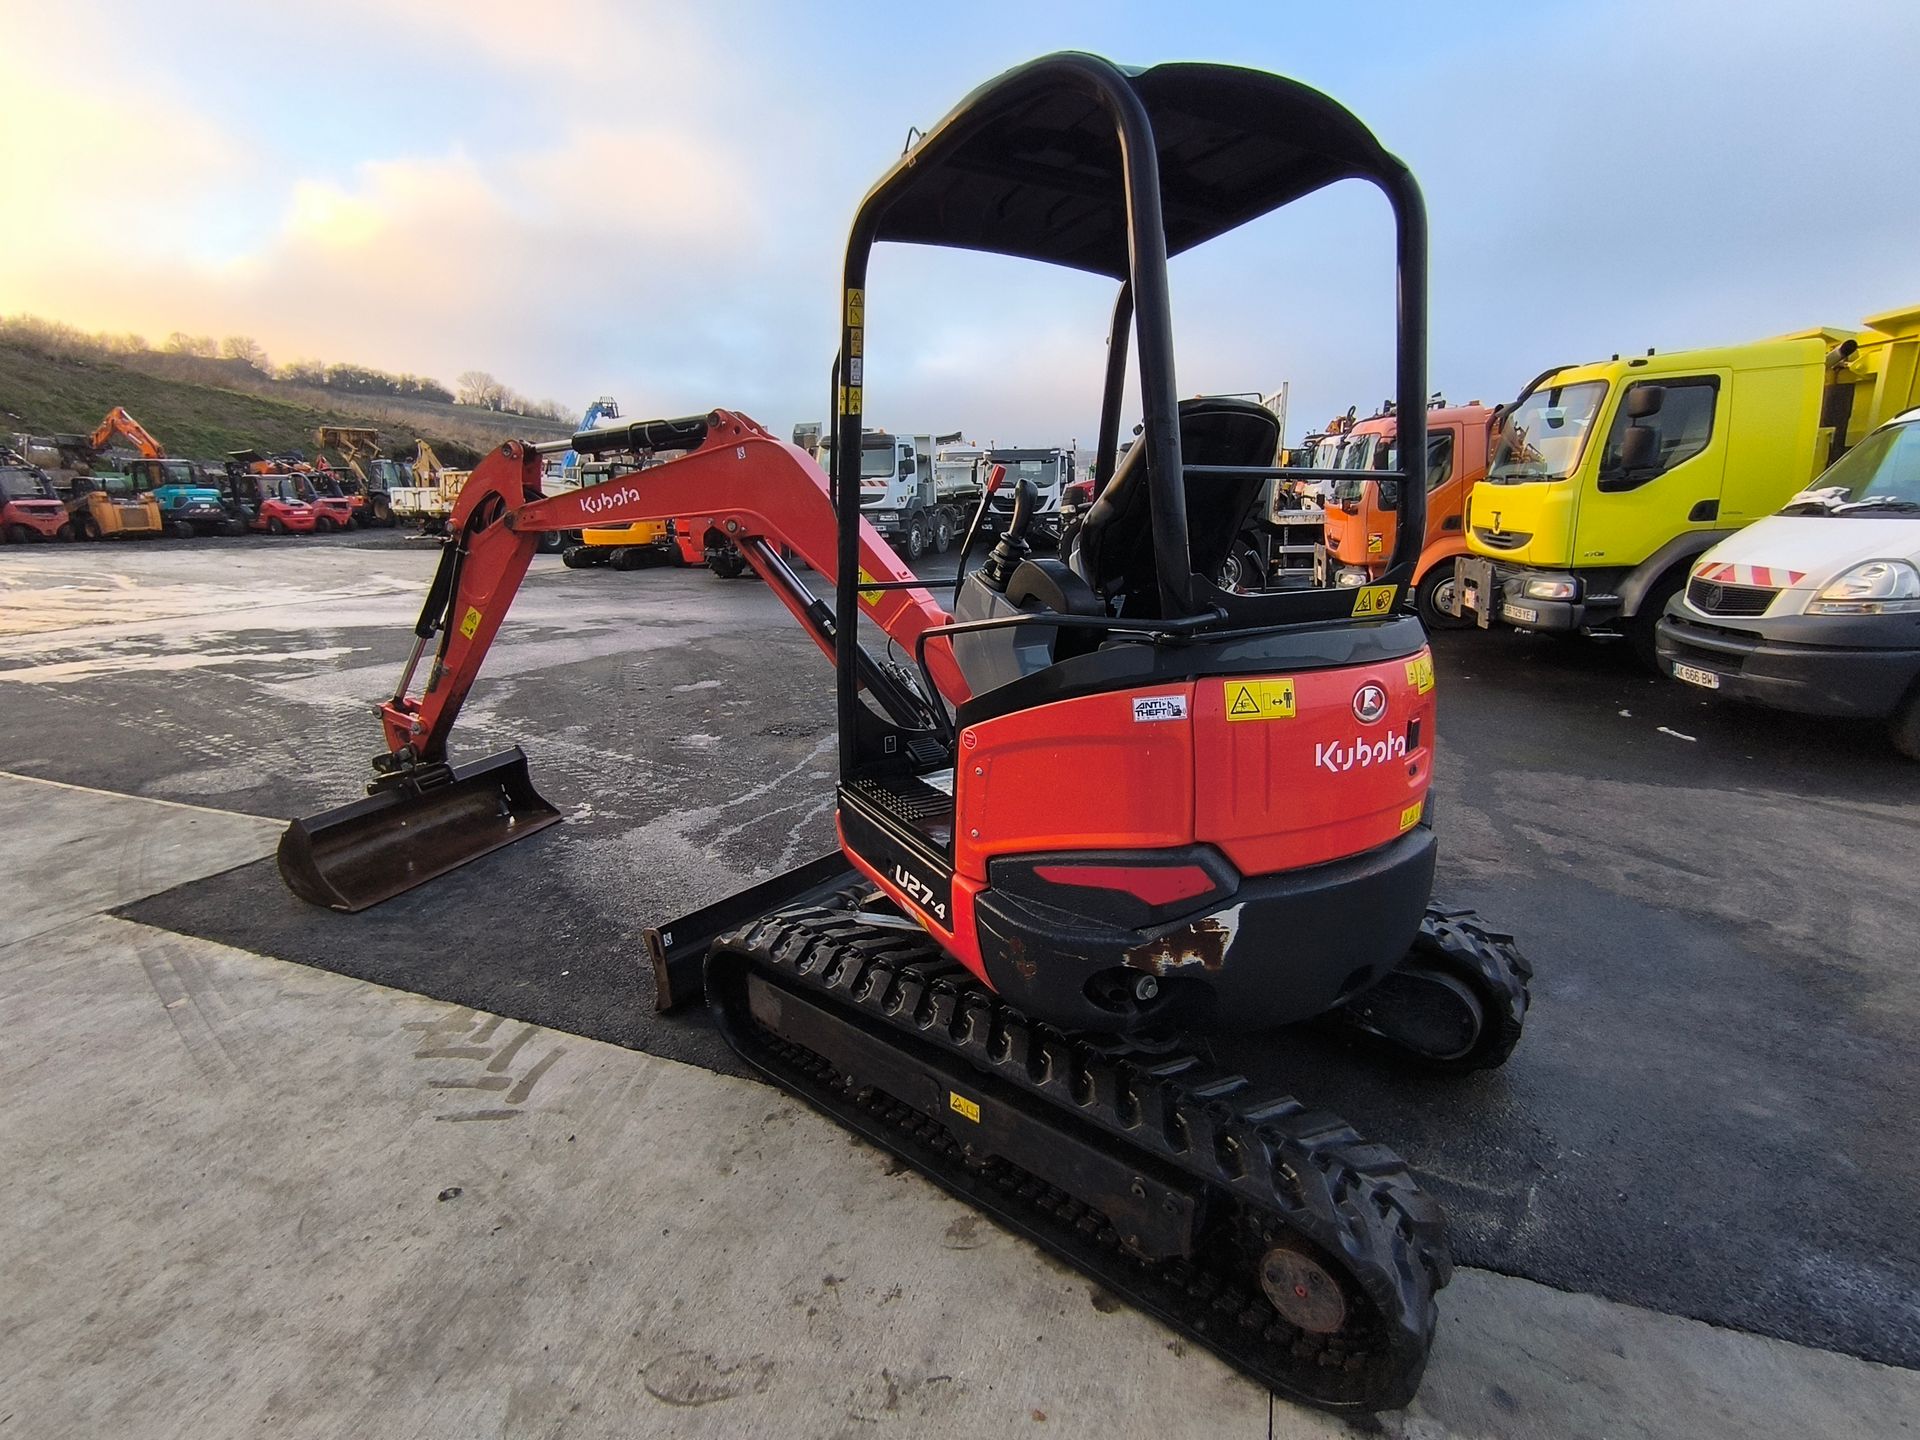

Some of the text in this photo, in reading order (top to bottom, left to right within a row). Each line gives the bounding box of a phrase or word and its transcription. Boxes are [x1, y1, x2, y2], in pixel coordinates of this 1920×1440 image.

[580, 487, 640, 514] Kubota
[1685, 668, 1700, 682] 666
[1135, 708, 1167, 717] THEFT
[1315, 731, 1406, 772] Kubota
[894, 864, 946, 920] U27-4
